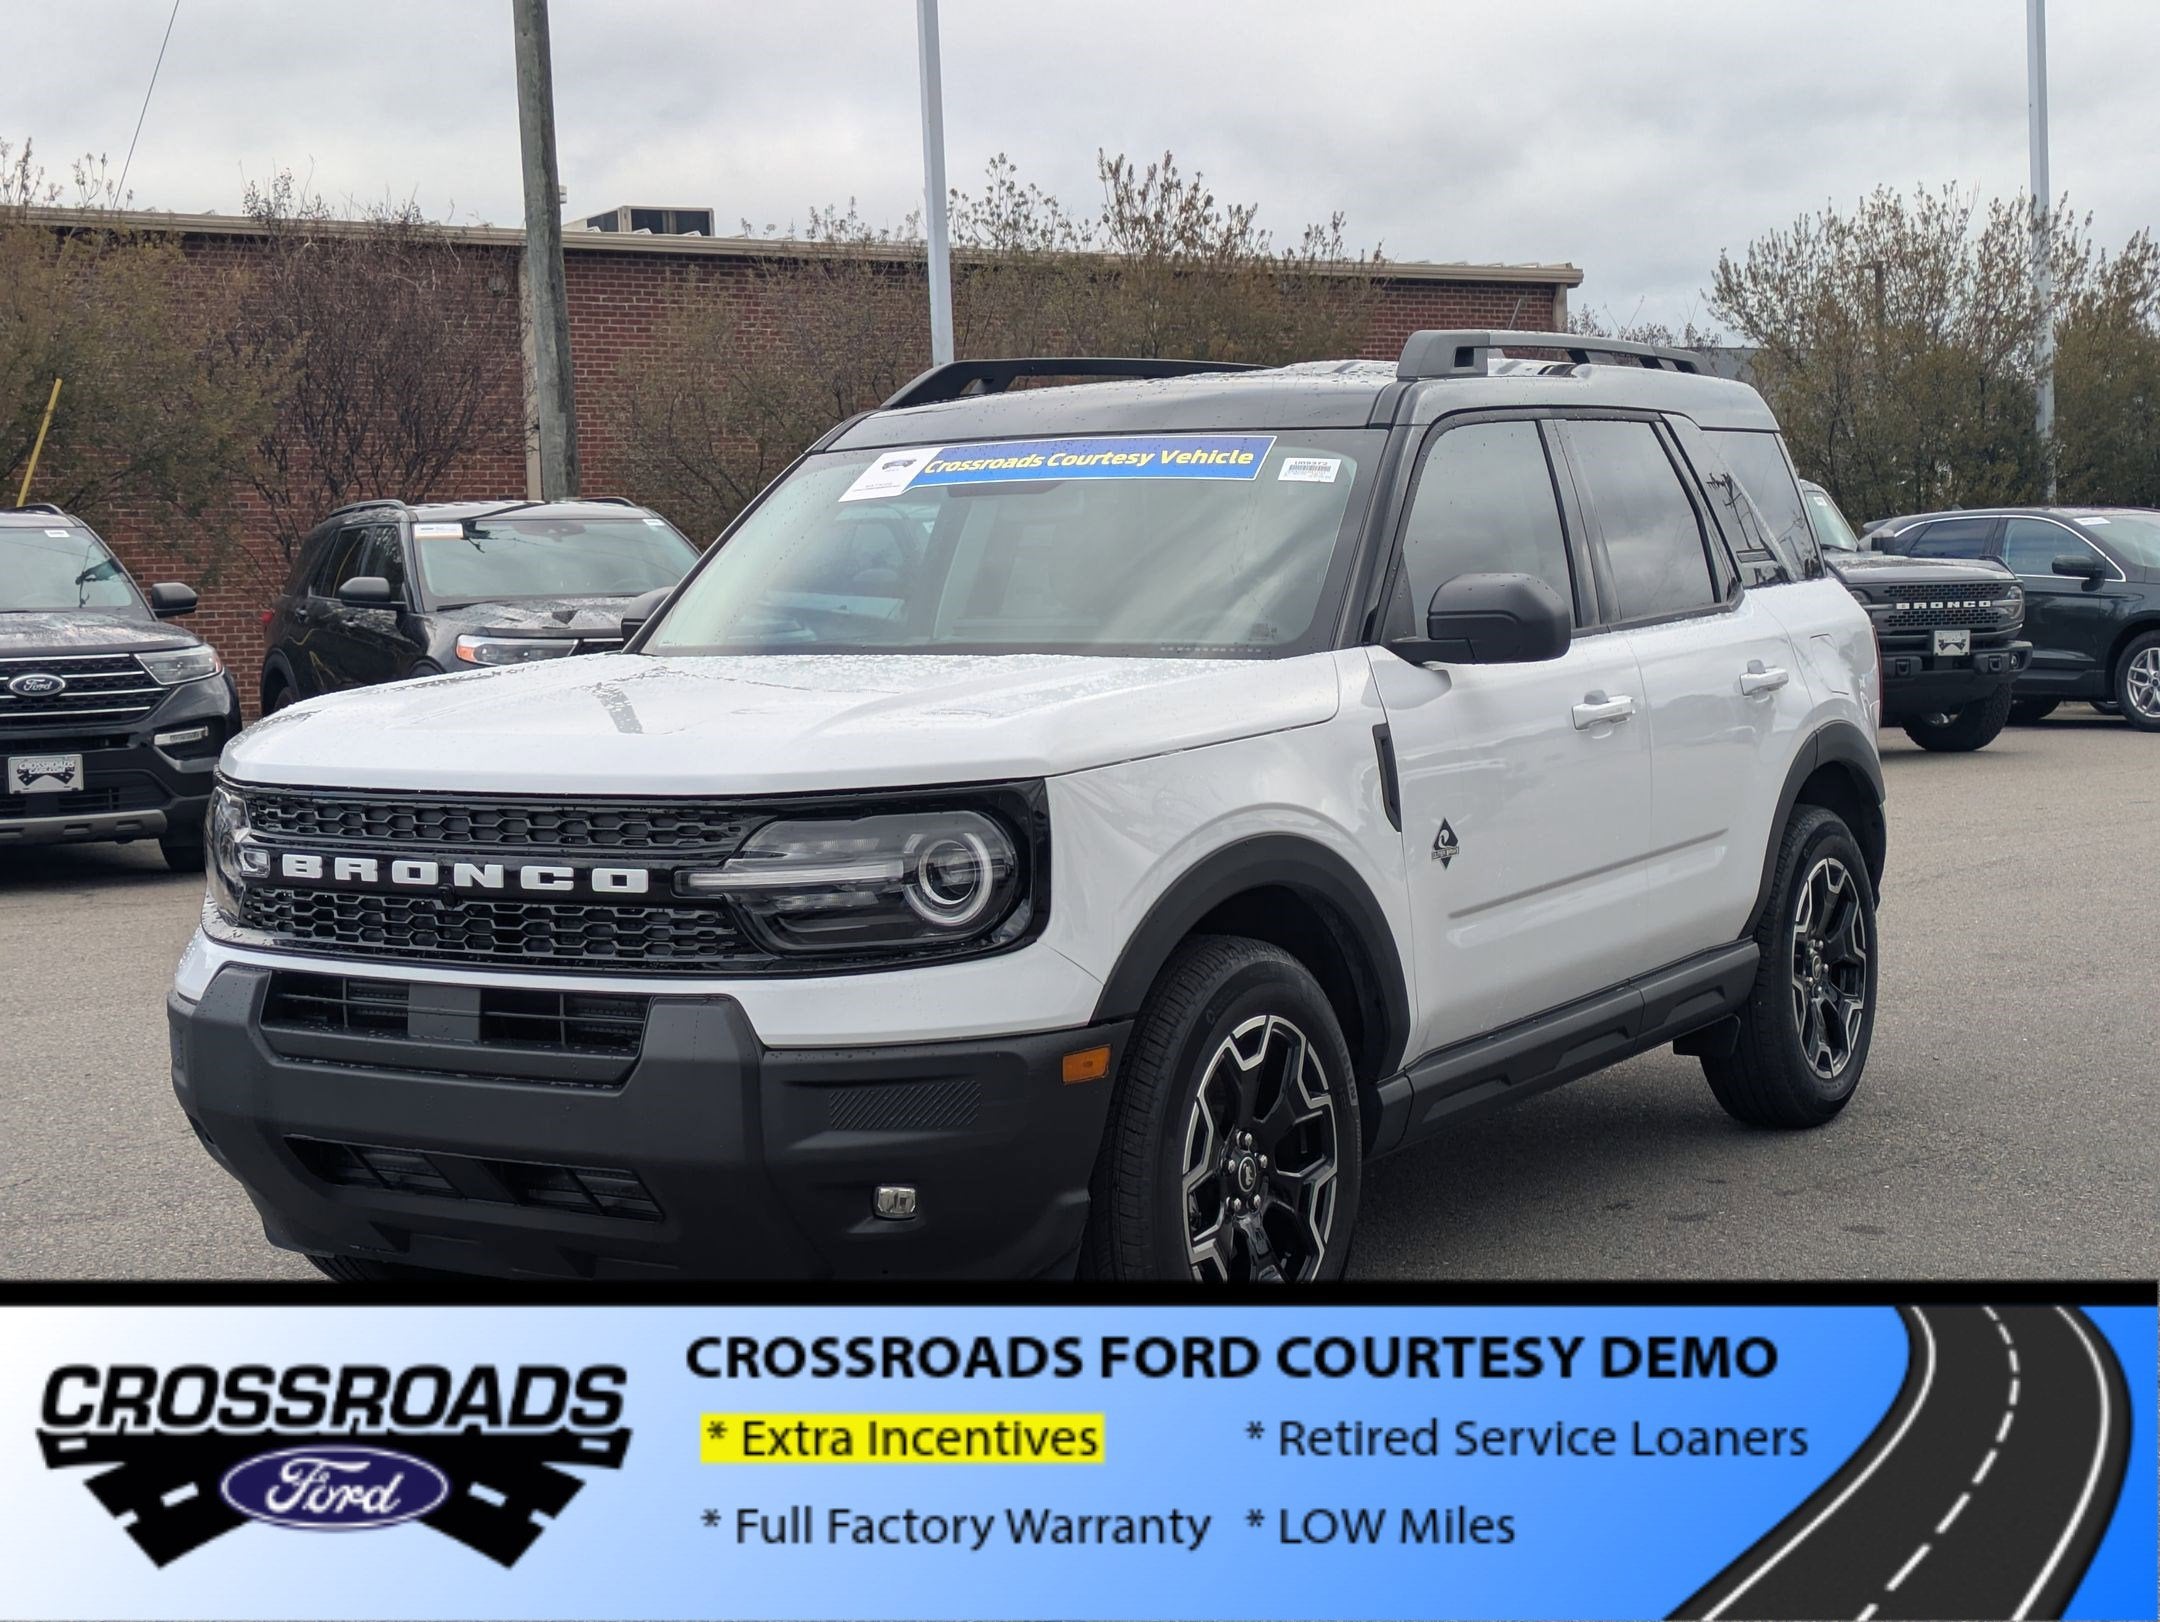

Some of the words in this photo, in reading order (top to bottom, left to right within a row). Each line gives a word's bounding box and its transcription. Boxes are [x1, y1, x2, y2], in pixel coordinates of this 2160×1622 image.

[923, 453, 1046, 474] Crossroads
[1047, 449, 1155, 467] Courtesy
[1161, 449, 1254, 465] Vehicle
[1895, 600, 1992, 610] BRONCO
[23, 678, 53, 691] Ford
[281, 853, 650, 894] BRONCO
